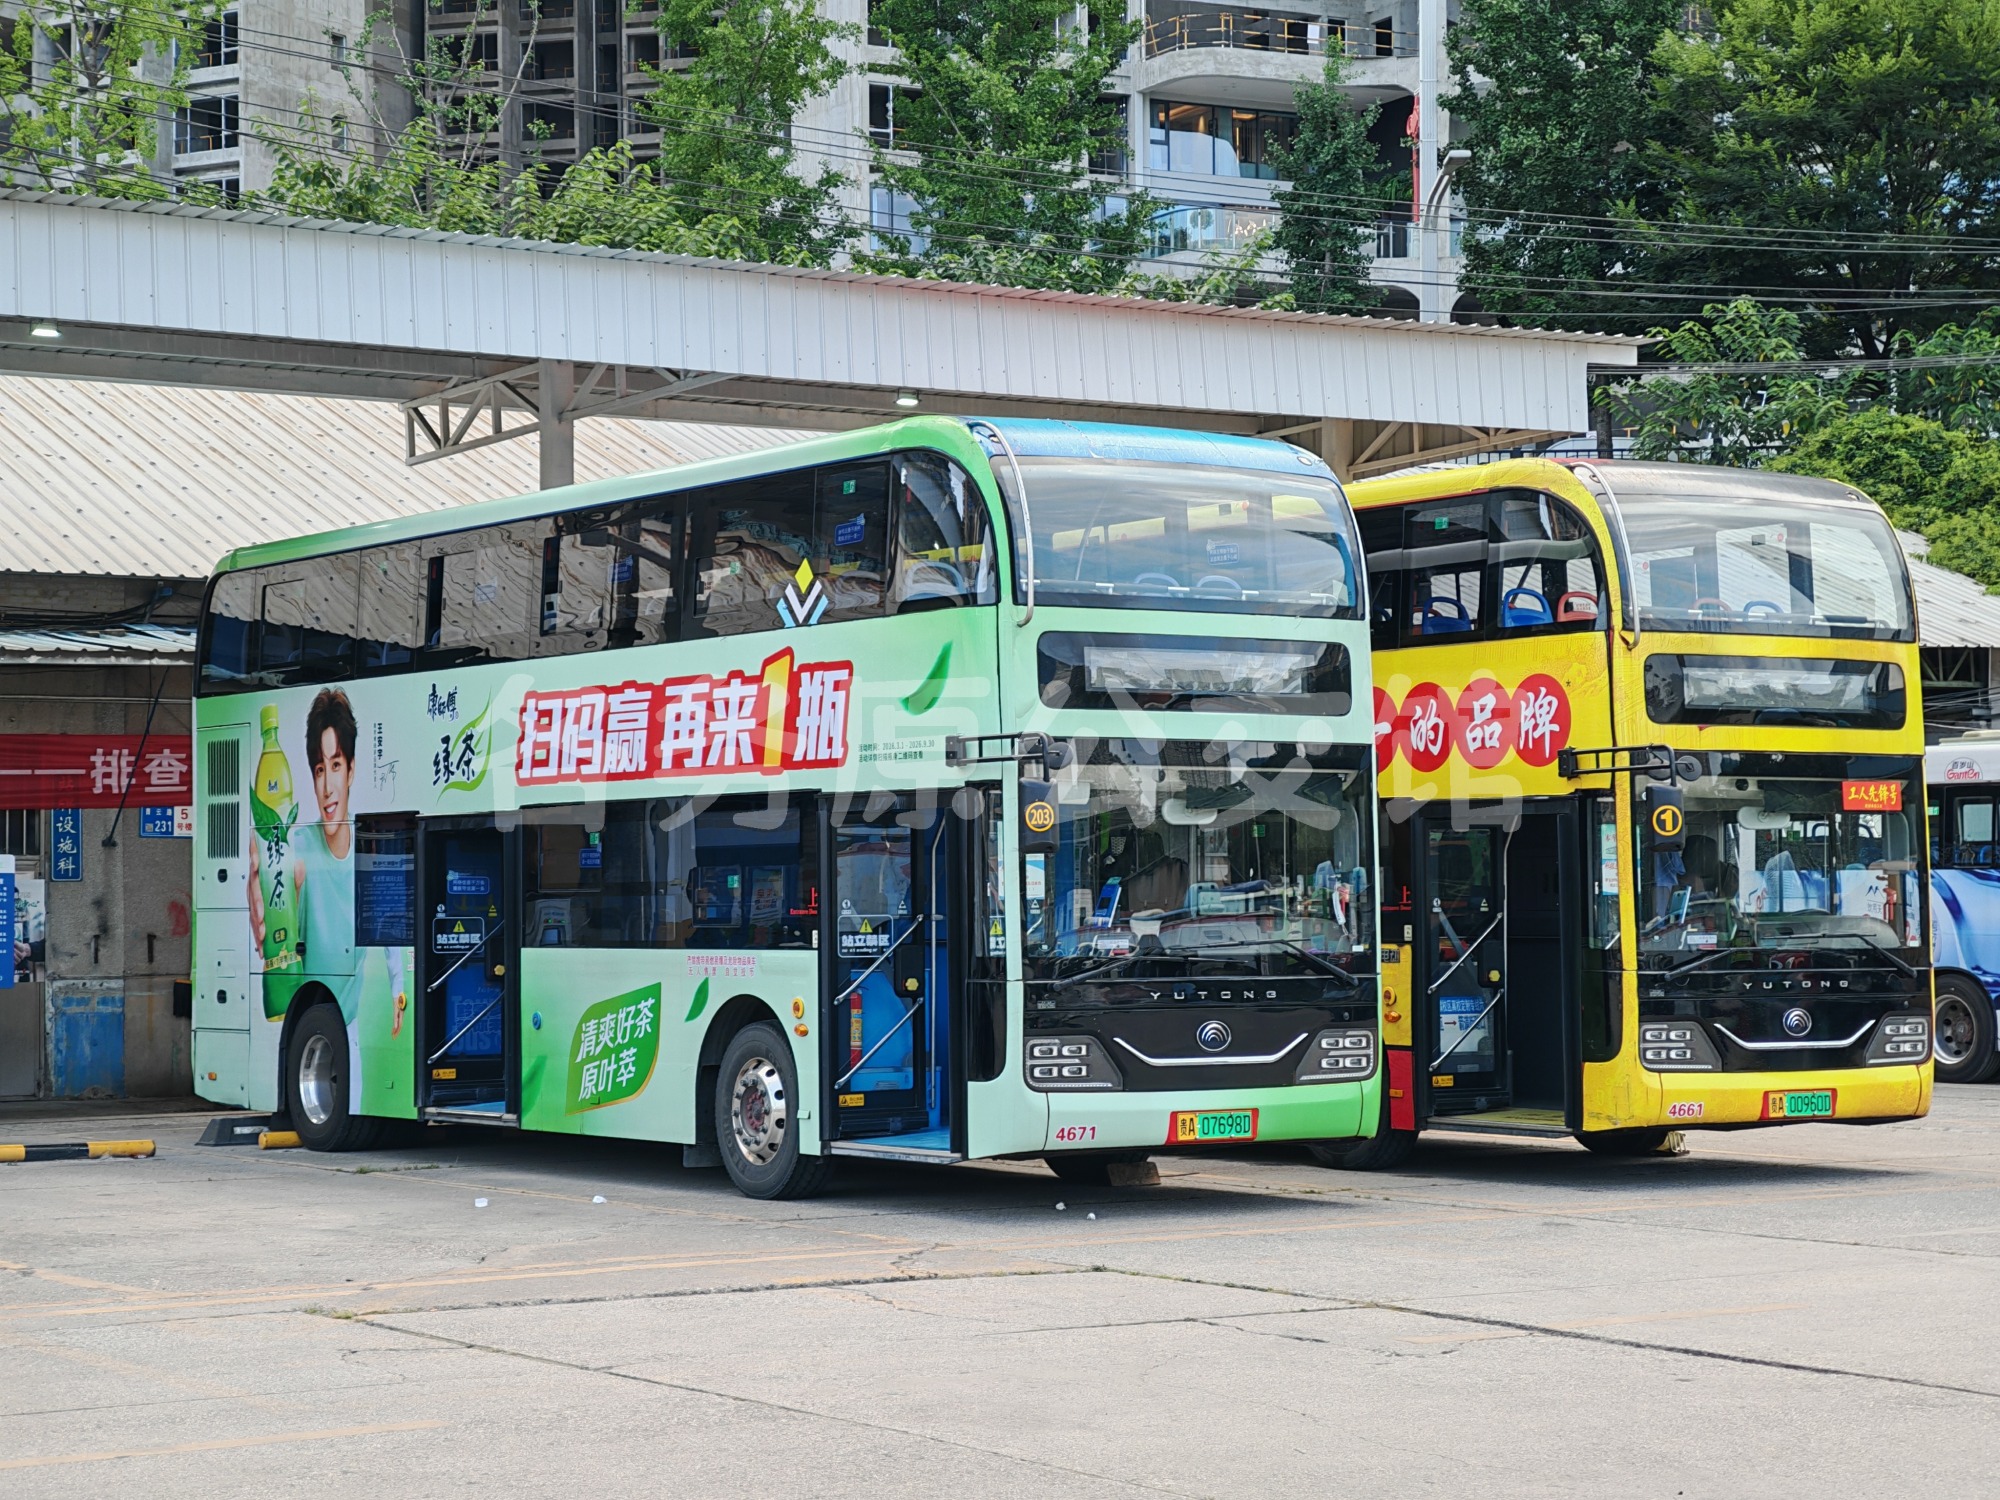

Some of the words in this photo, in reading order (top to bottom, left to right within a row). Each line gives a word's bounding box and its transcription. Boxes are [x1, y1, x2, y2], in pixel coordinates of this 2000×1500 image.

[518, 691, 651, 779] 扫码赢
[660, 655, 851, 772] 再来1瓶
[433, 729, 476, 786] 绿茶
[1847, 783, 1898, 805] 工人先锋号
[180, 808, 189, 820] 5
[1029, 807, 1051, 826] 203
[154, 820, 172, 833] 231
[436, 933, 482, 944] 站立禁区
[841, 934, 890, 947] 站立禁区
[1743, 979, 1849, 989] YUTONG
[1150, 991, 1277, 1000] YUTONG
[575, 996, 655, 1064] 清爽好茶
[578, 1046, 637, 1102] 原叶萃
[1667, 1101, 1704, 1119] 4661
[1055, 1125, 1097, 1143] 4671
